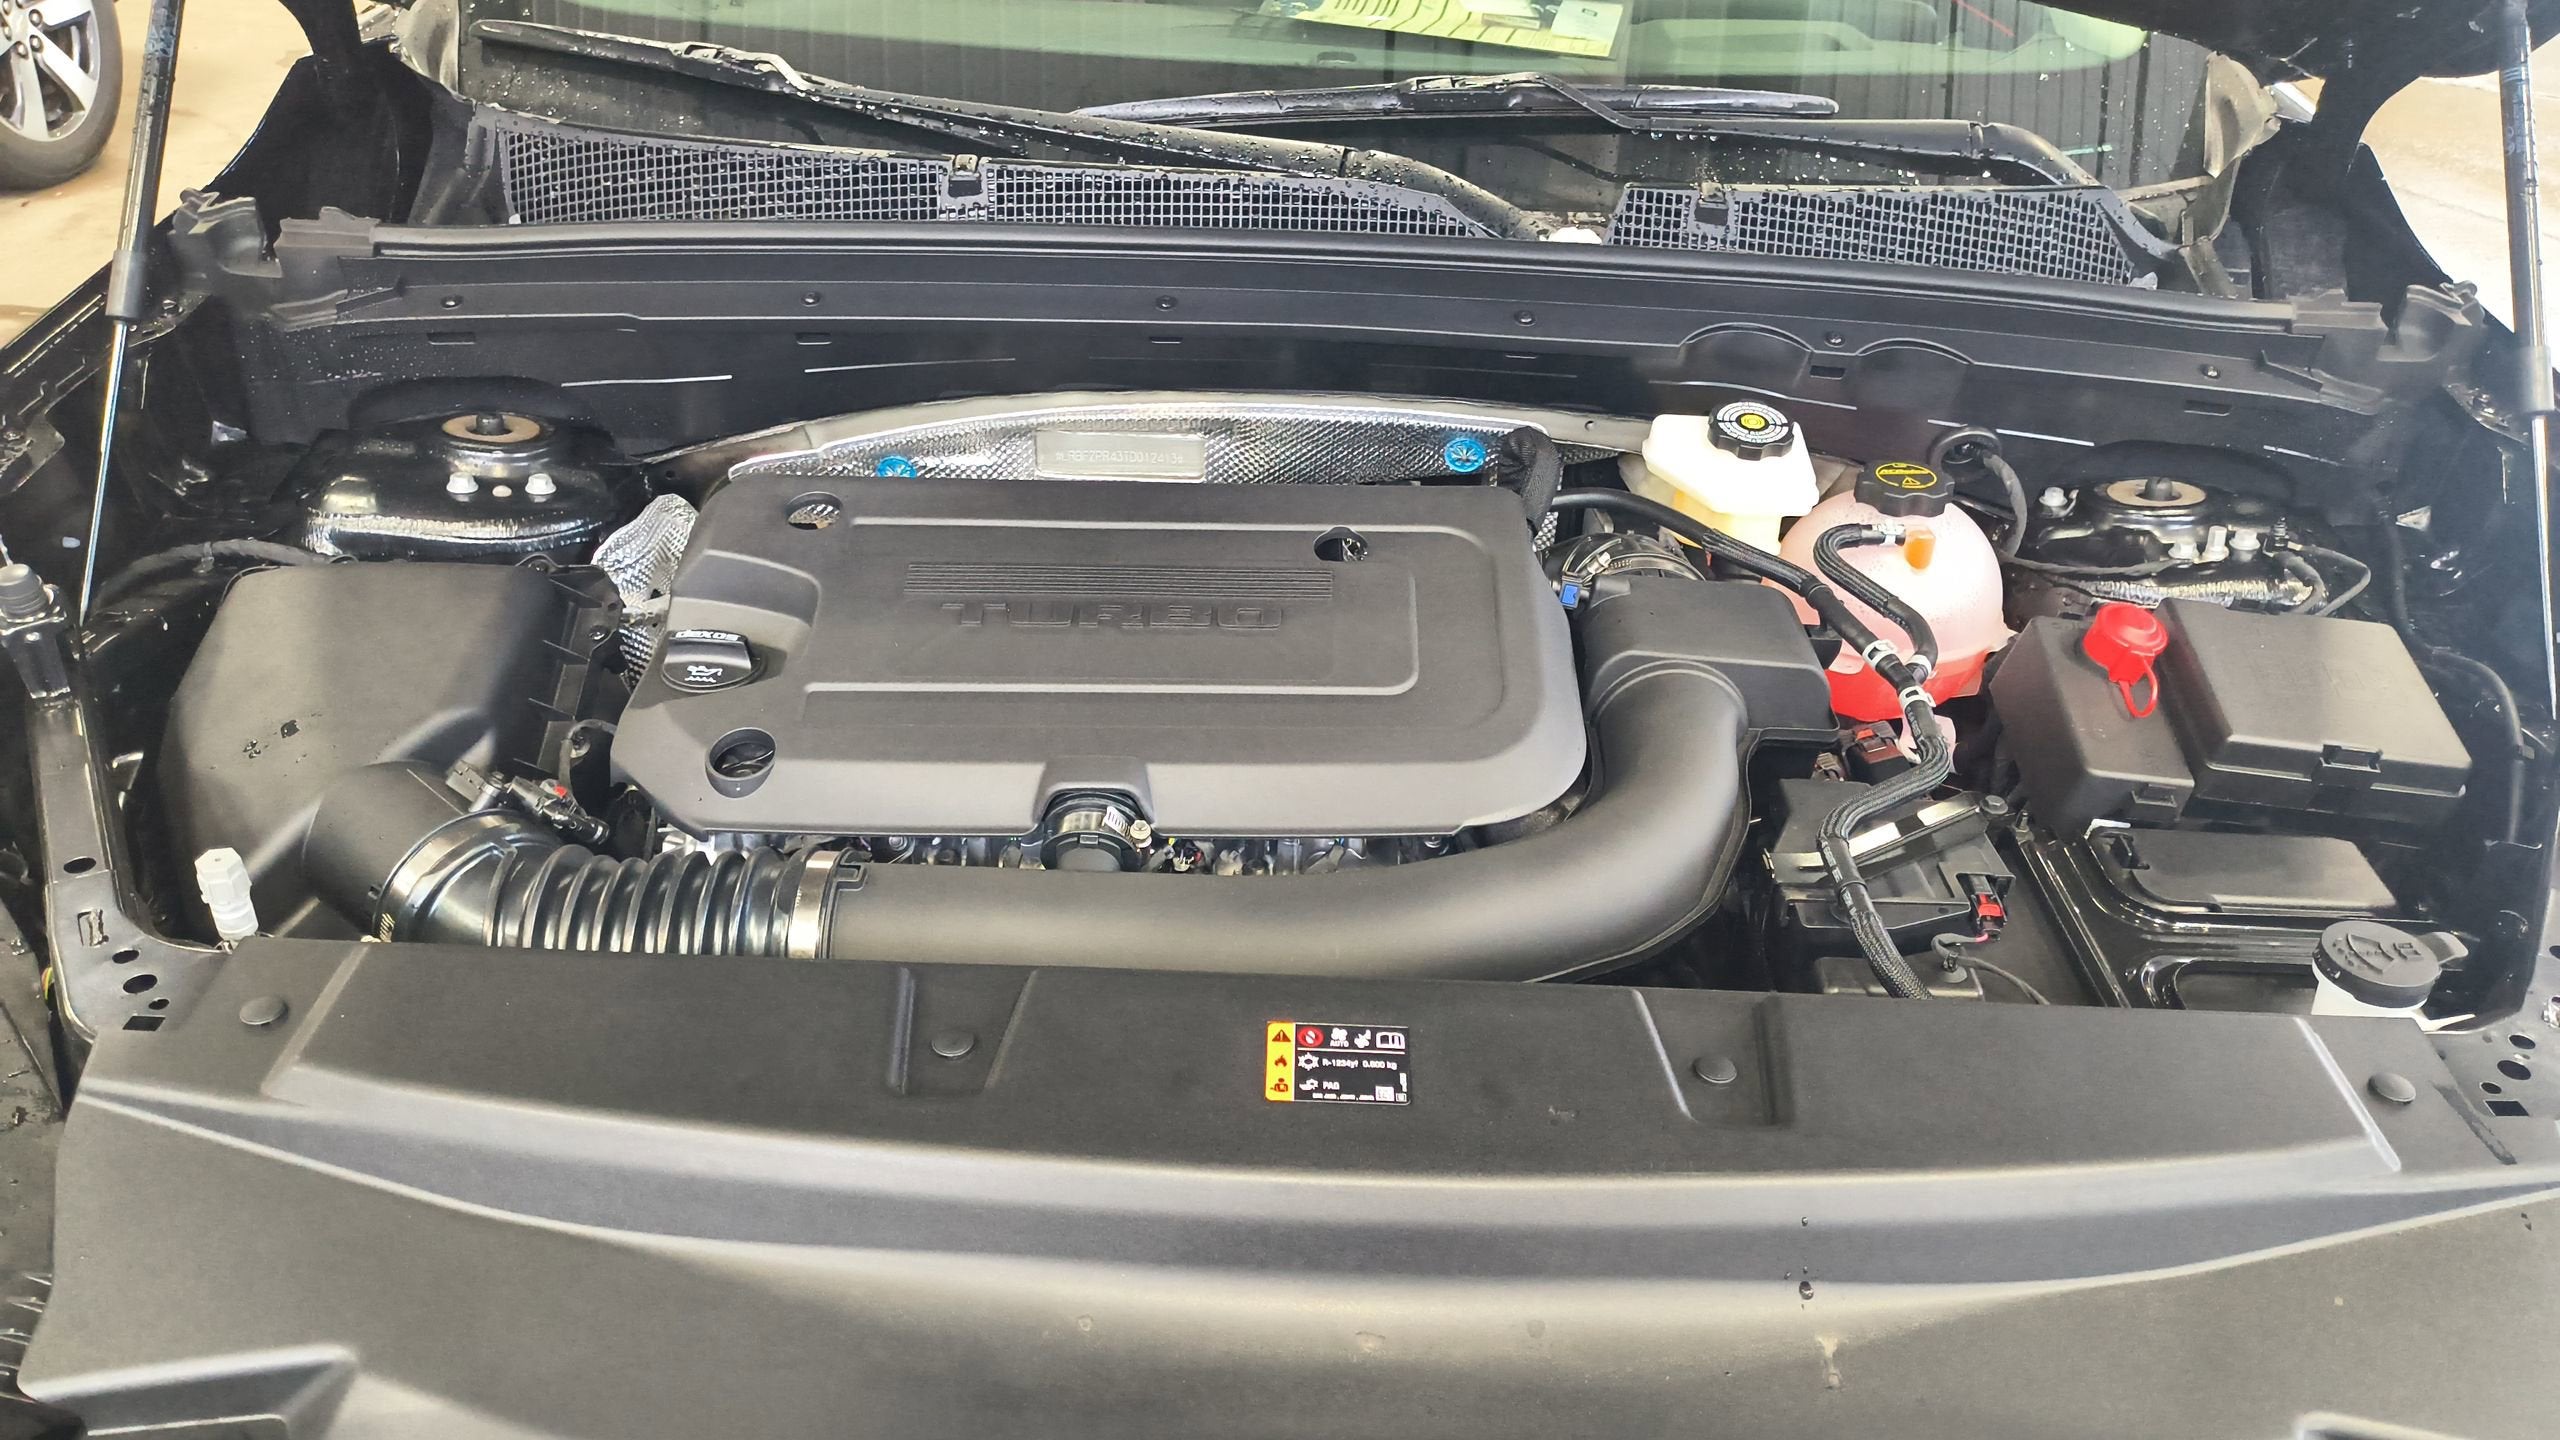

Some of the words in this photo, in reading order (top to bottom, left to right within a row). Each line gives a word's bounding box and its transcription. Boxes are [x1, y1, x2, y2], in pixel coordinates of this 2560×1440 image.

[942, 602, 1283, 630] TURBO
[675, 629, 741, 641] dexos
[1330, 1040, 1349, 1048] AUTO
